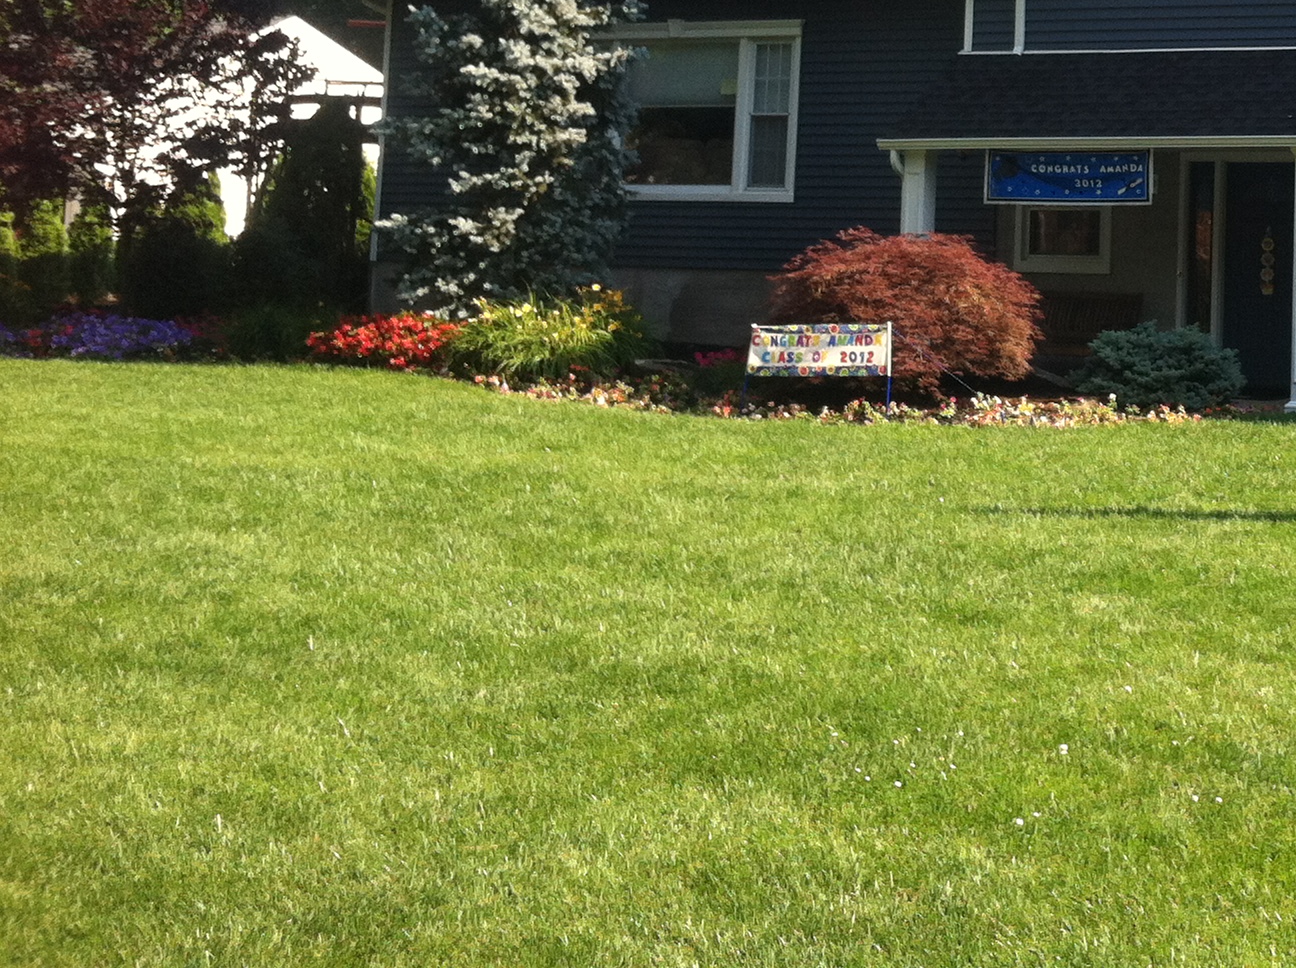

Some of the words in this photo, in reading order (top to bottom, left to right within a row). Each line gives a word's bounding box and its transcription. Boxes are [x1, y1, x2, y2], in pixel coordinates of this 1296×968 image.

[1030, 164, 1090, 174] CONGRATS
[1099, 163, 1144, 173] AMANDA
[1074, 178, 1103, 188] 2012
[751, 334, 821, 347] CONGRATS
[827, 334, 883, 347] AMANDA
[761, 351, 804, 363] CLASS
[812, 351, 829, 363] OF
[840, 351, 875, 363] 2012
